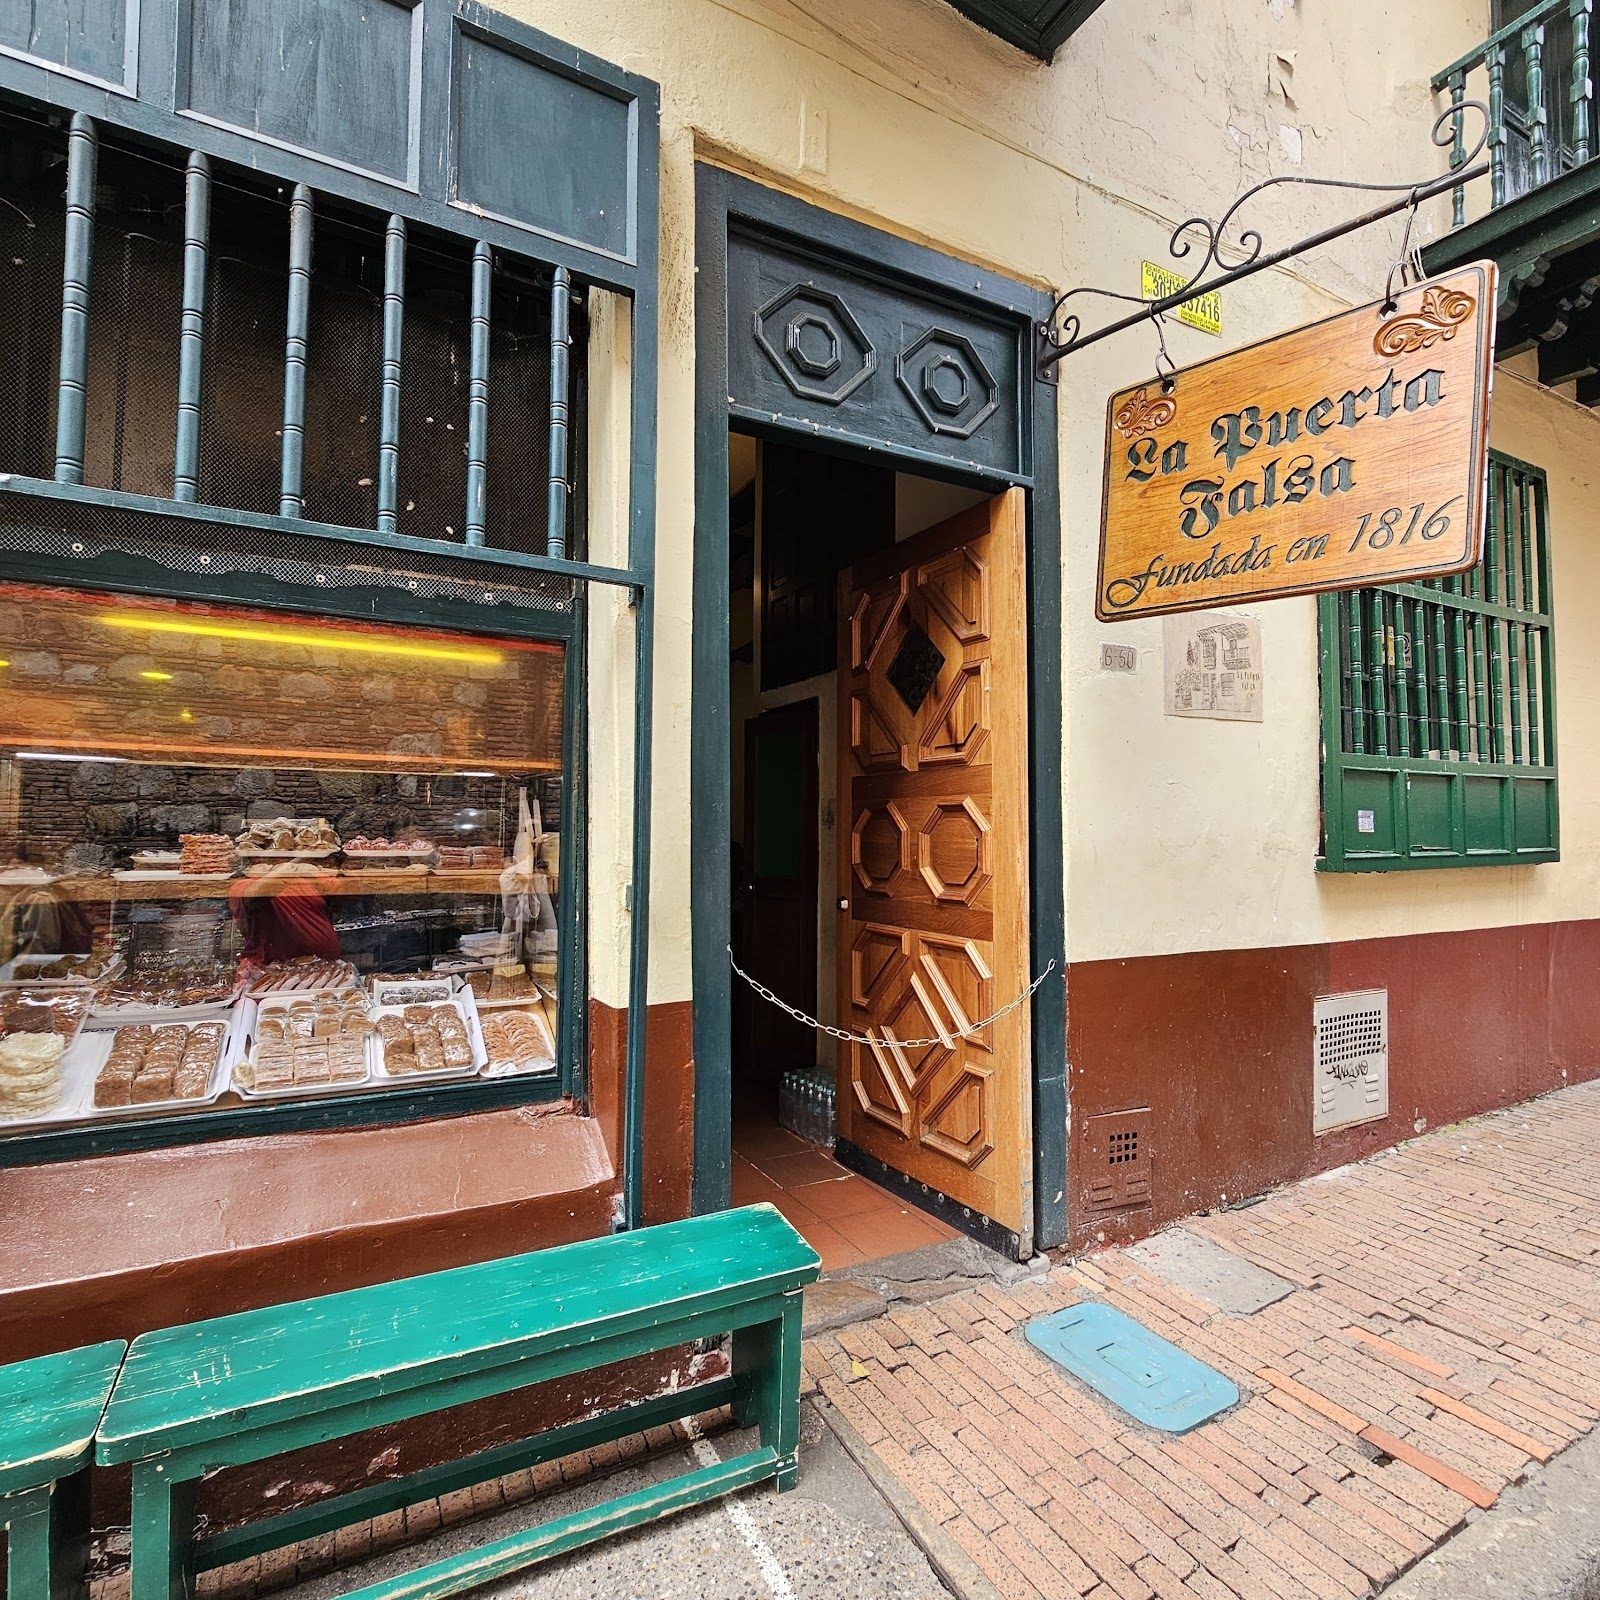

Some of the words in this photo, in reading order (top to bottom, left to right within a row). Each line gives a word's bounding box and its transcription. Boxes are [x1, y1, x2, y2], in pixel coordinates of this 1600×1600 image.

[1125, 437, 1189, 482] La
[1211, 368, 1446, 473] Puerta
[1179, 454, 1357, 539] Falsa
[1285, 532, 1330, 564] en
[1347, 494, 1463, 554] 1816
[1104, 646, 1134, 670] 6-50
